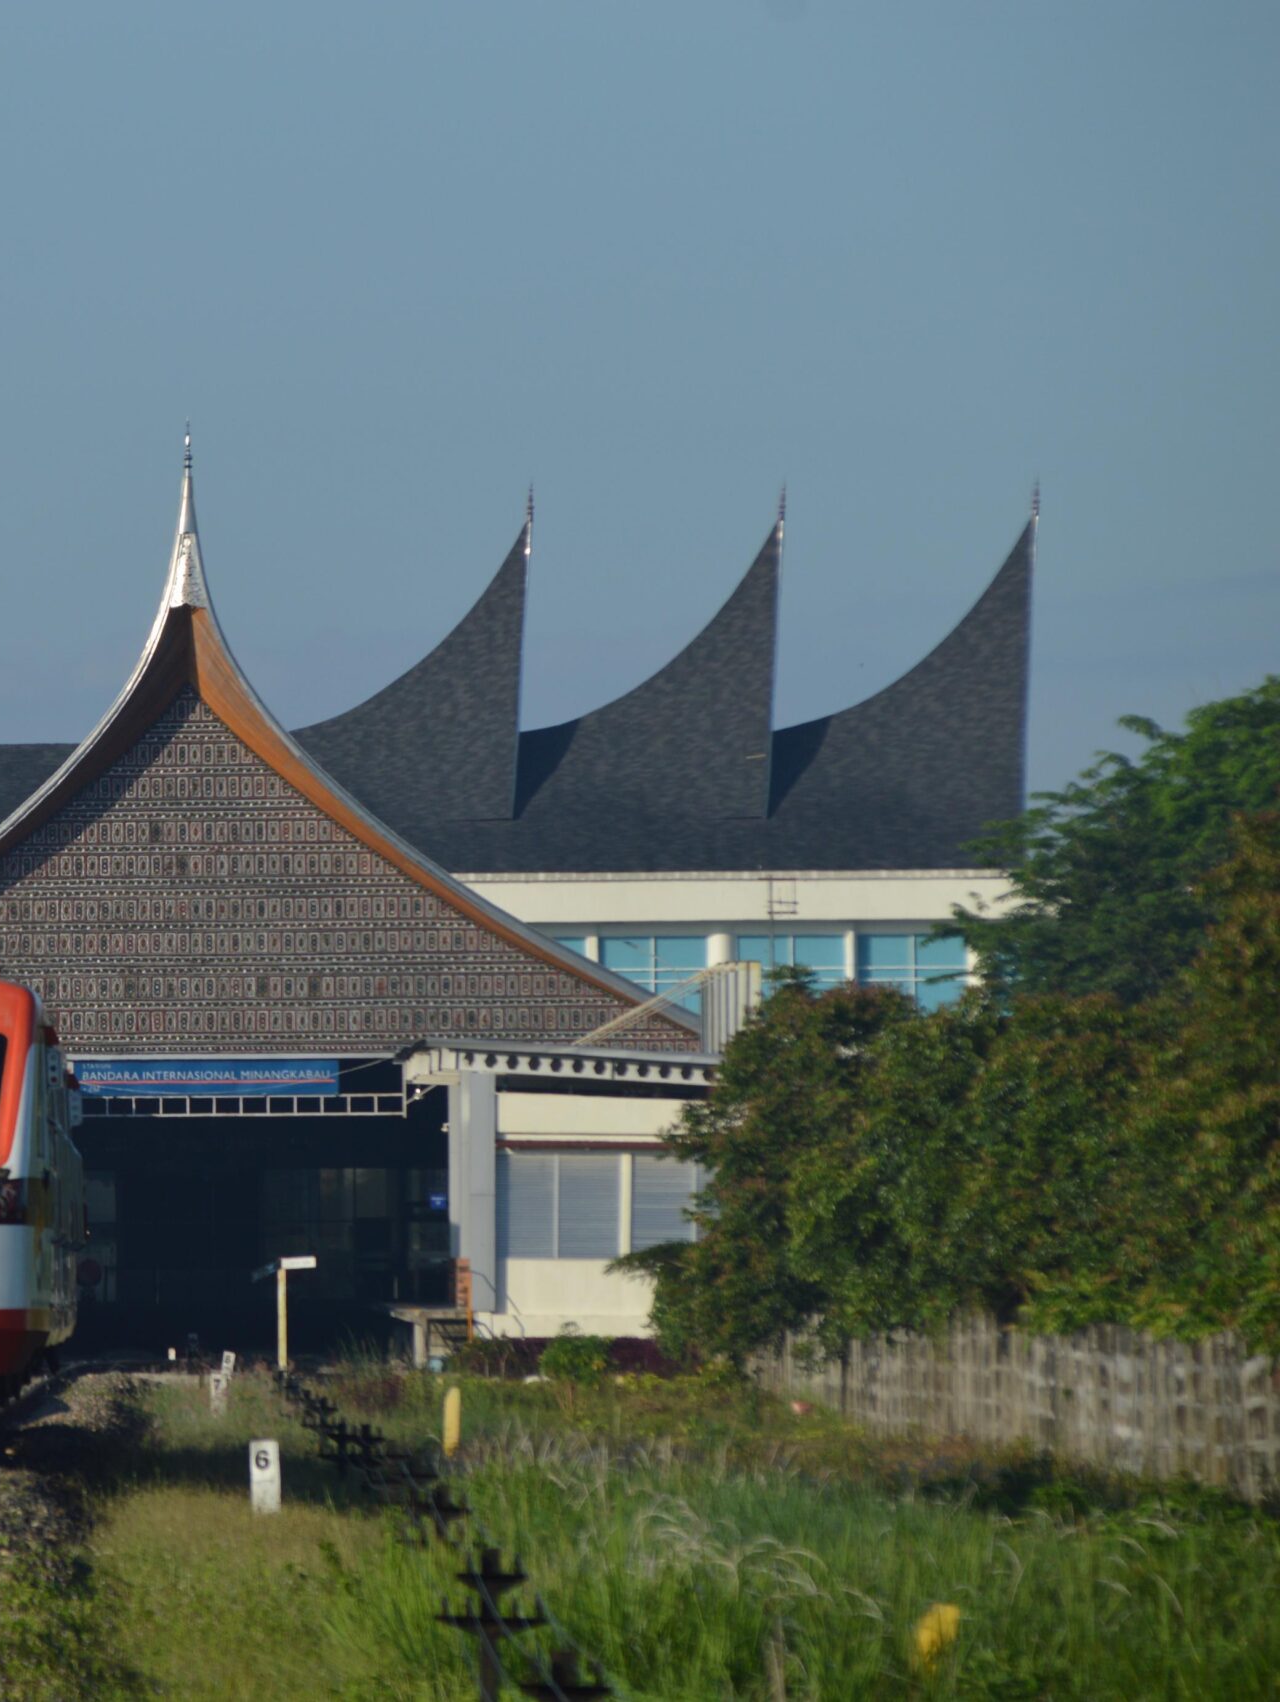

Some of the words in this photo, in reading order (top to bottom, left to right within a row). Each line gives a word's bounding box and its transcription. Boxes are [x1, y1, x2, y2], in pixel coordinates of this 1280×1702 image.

[82, 1070, 140, 1080] BANDARA
[142, 1070, 238, 1080] INTERNASIONAL
[241, 1069, 331, 1080] MINANGKABAU
[255, 1449, 270, 1470] 6
